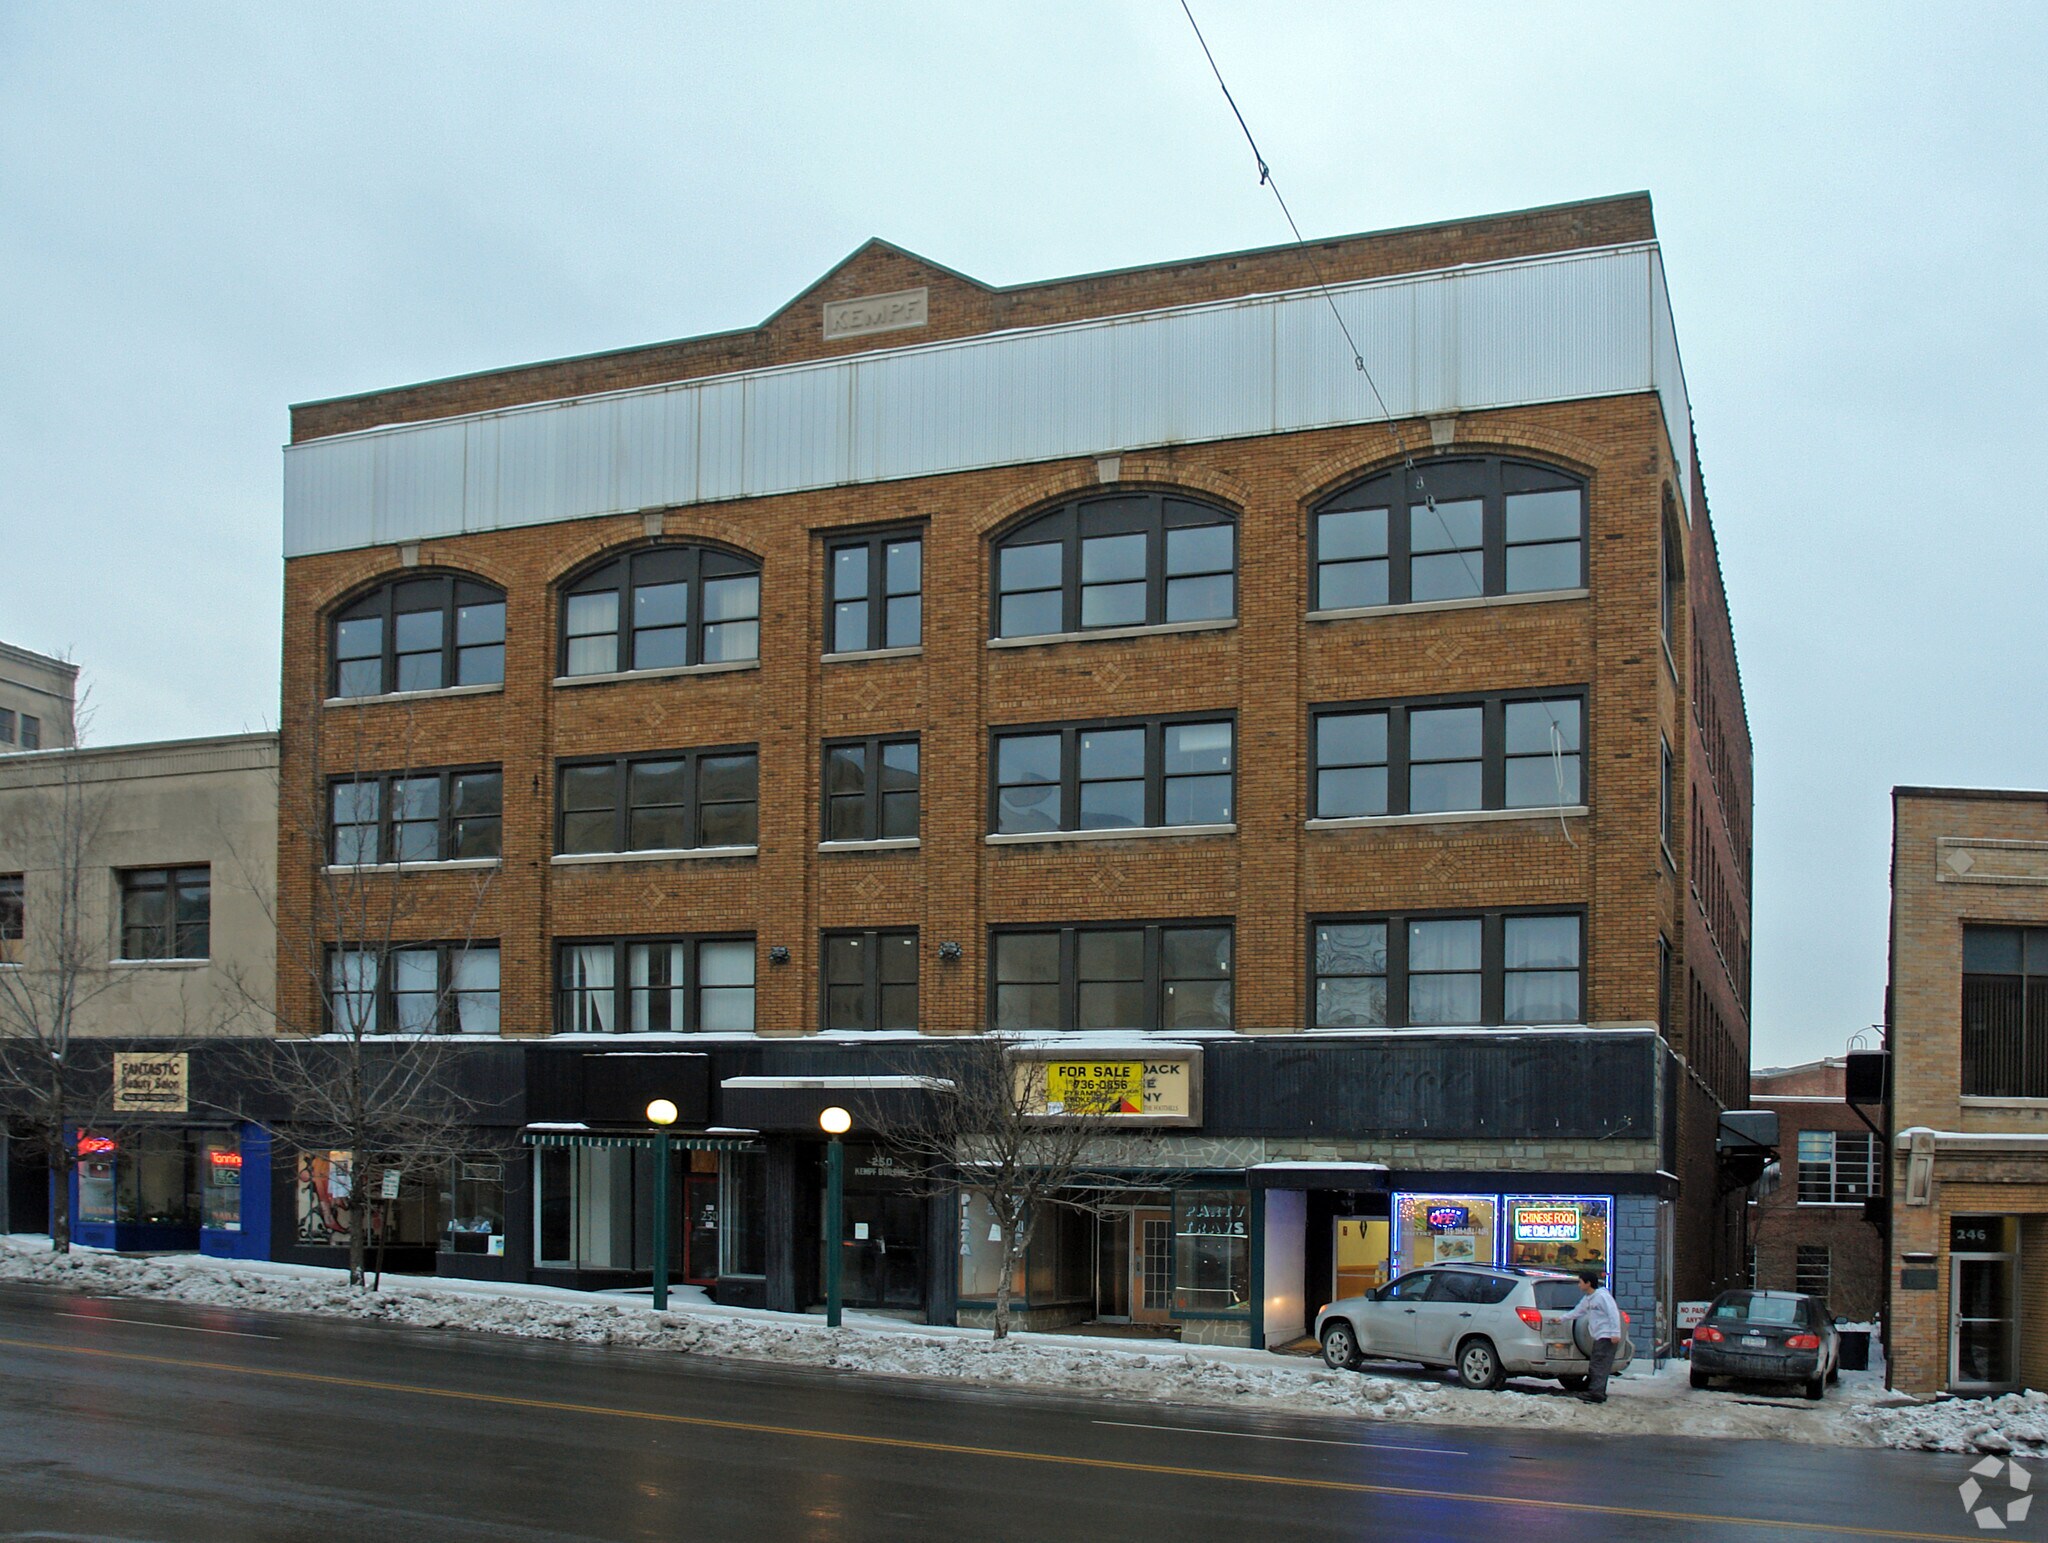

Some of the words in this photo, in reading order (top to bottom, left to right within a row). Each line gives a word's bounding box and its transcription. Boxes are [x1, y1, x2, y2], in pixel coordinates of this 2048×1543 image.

[832, 299, 922, 332] KEMPF
[122, 1062, 180, 1076] FANTASTIC
[1059, 1066, 1086, 1077] FOR
[1093, 1066, 1131, 1078] SALE
[122, 1077, 152, 1091] Beauty
[155, 1078, 180, 1089] Salon
[871, 1157, 893, 1166] 250
[854, 1167, 877, 1175] KEMPF
[701, 1211, 719, 1221] 250
[1430, 1213, 1464, 1224] OPEN
[1520, 1212, 1554, 1224] CHINESE
[1554, 1212, 1575, 1224] FOOD
[1519, 1225, 1533, 1237] WE
[1533, 1225, 1576, 1237] DELIVERY
[1956, 1229, 1986, 1240] 246
